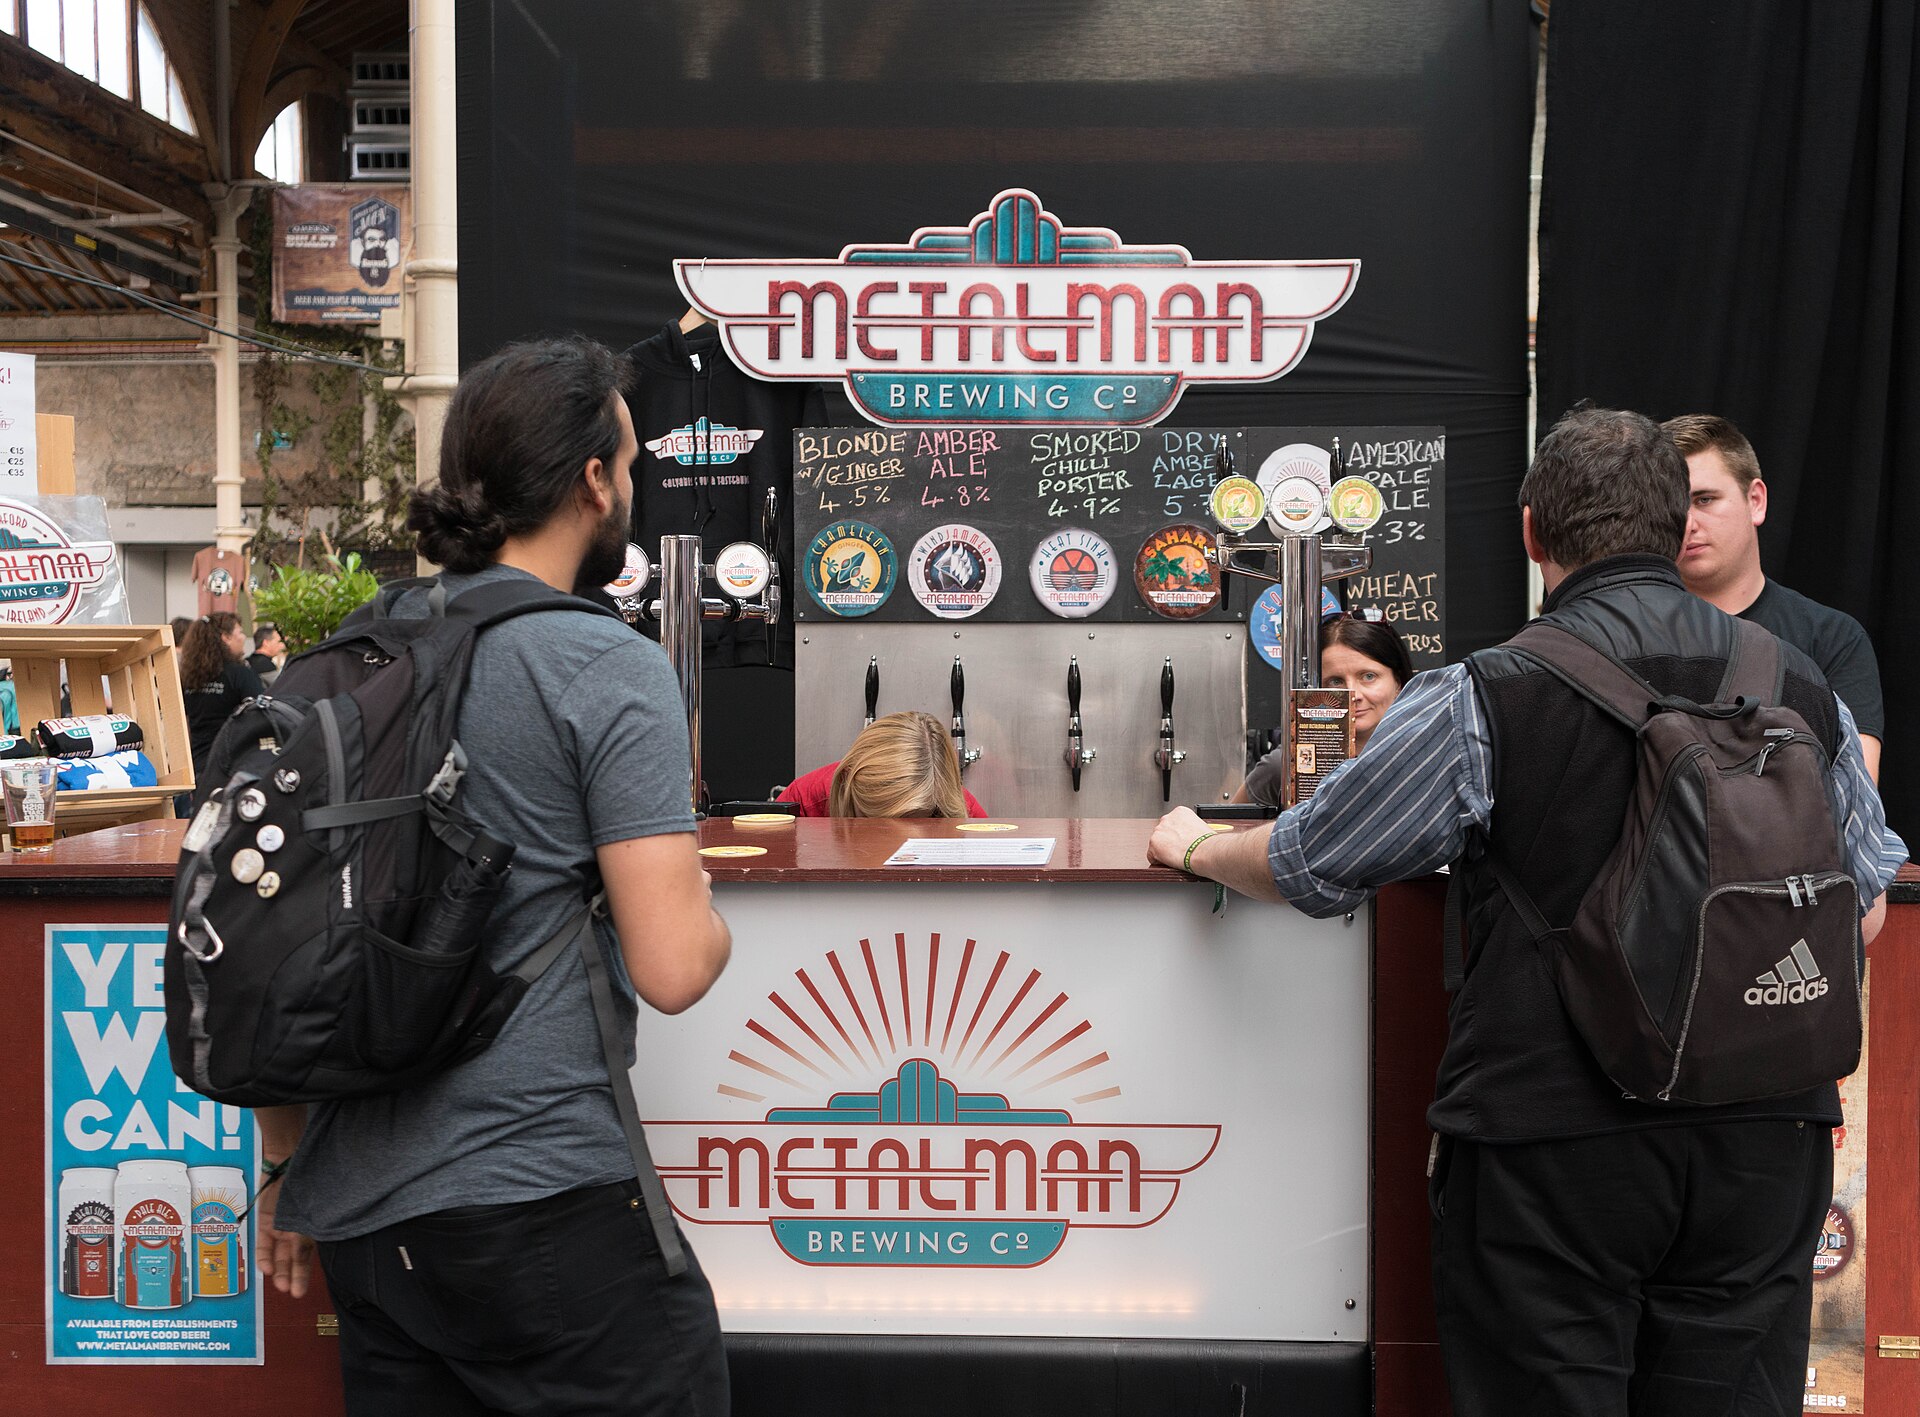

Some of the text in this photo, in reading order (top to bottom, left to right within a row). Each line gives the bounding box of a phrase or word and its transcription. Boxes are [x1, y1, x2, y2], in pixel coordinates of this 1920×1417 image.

[767, 280, 1264, 363] METALMAN
[889, 383, 1071, 410] BREWING
[9, 446, 25, 455] €15
[660, 433, 749, 455] METAMAN
[799, 431, 907, 464] BLONDE
[913, 428, 1001, 458] AMBER
[1030, 427, 1141, 464] SMOKED
[1161, 431, 1220, 453] DRY
[1345, 434, 1446, 469] AMERICAN
[7, 457, 25, 466] €25
[682, 455, 718, 463] BRWIG
[929, 452, 987, 480] ALE
[1042, 456, 1111, 477] CHILLI
[1152, 452, 1235, 473] AMBE
[7, 468, 25, 477] €35
[1154, 471, 1240, 490] LAGE
[1364, 465, 1432, 488] PALE
[1038, 470, 1134, 498] PORTER
[819, 485, 891, 514] 4.5%
[920, 486, 991, 508] 4.8%
[1048, 497, 1121, 519] 4.9%
[811, 524, 890, 556] CHAMELEON
[917, 528, 992, 556] WINDJAMMER
[1041, 533, 1108, 559] HEAT SINK
[1346, 570, 1438, 600] WHEAT
[826, 594, 876, 603] METALMAN
[926, 593, 983, 604] METALMAN
[1049, 592, 1099, 602] METALMAN
[1157, 593, 1208, 602] METALMAN
[6, 606, 46, 624] IRELAND
[1352, 599, 1440, 622] GER
[1303, 709, 1342, 717] METALMAN
[62, 943, 167, 1007] YE
[1743, 976, 1829, 1006] adidas
[63, 1099, 241, 1151] CAN!
[697, 1136, 1142, 1213] METALMAN
[134, 1203, 172, 1219] PALE ALE
[71, 1225, 115, 1235] METALMAN
[127, 1225, 179, 1235] METALMAN
[192, 1224, 235, 1234] METALMAN
[807, 1230, 969, 1254] BREWING
[67, 1320, 238, 1328] AVAILABLE FROM ESTABLISHMENTS
[96, 1330, 211, 1339] THAT LOVE GOOD BEER!
[76, 1342, 231, 1350] WWW.METALMANBREWING.COM
